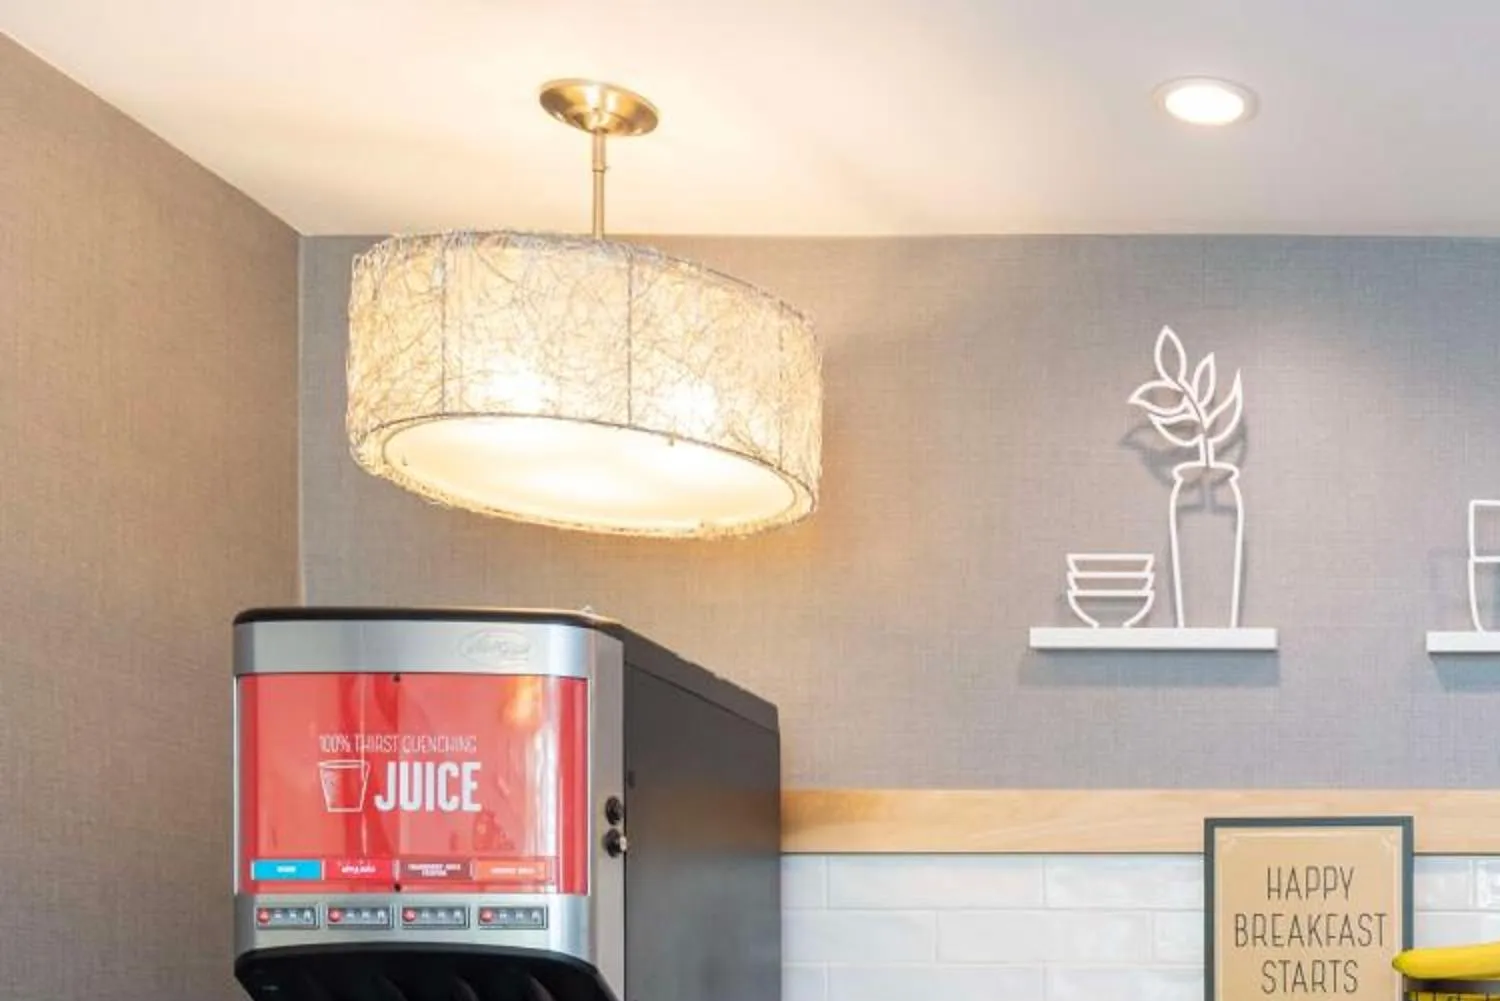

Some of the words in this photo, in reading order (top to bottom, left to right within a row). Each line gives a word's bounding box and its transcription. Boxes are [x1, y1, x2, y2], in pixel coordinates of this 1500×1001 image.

[355, 734, 399, 753] THIRST
[373, 760, 483, 812] JUICE
[1266, 865, 1355, 901] HAPPY
[1234, 912, 1388, 948] BREAKFAST
[1260, 959, 1359, 995] STARTS
